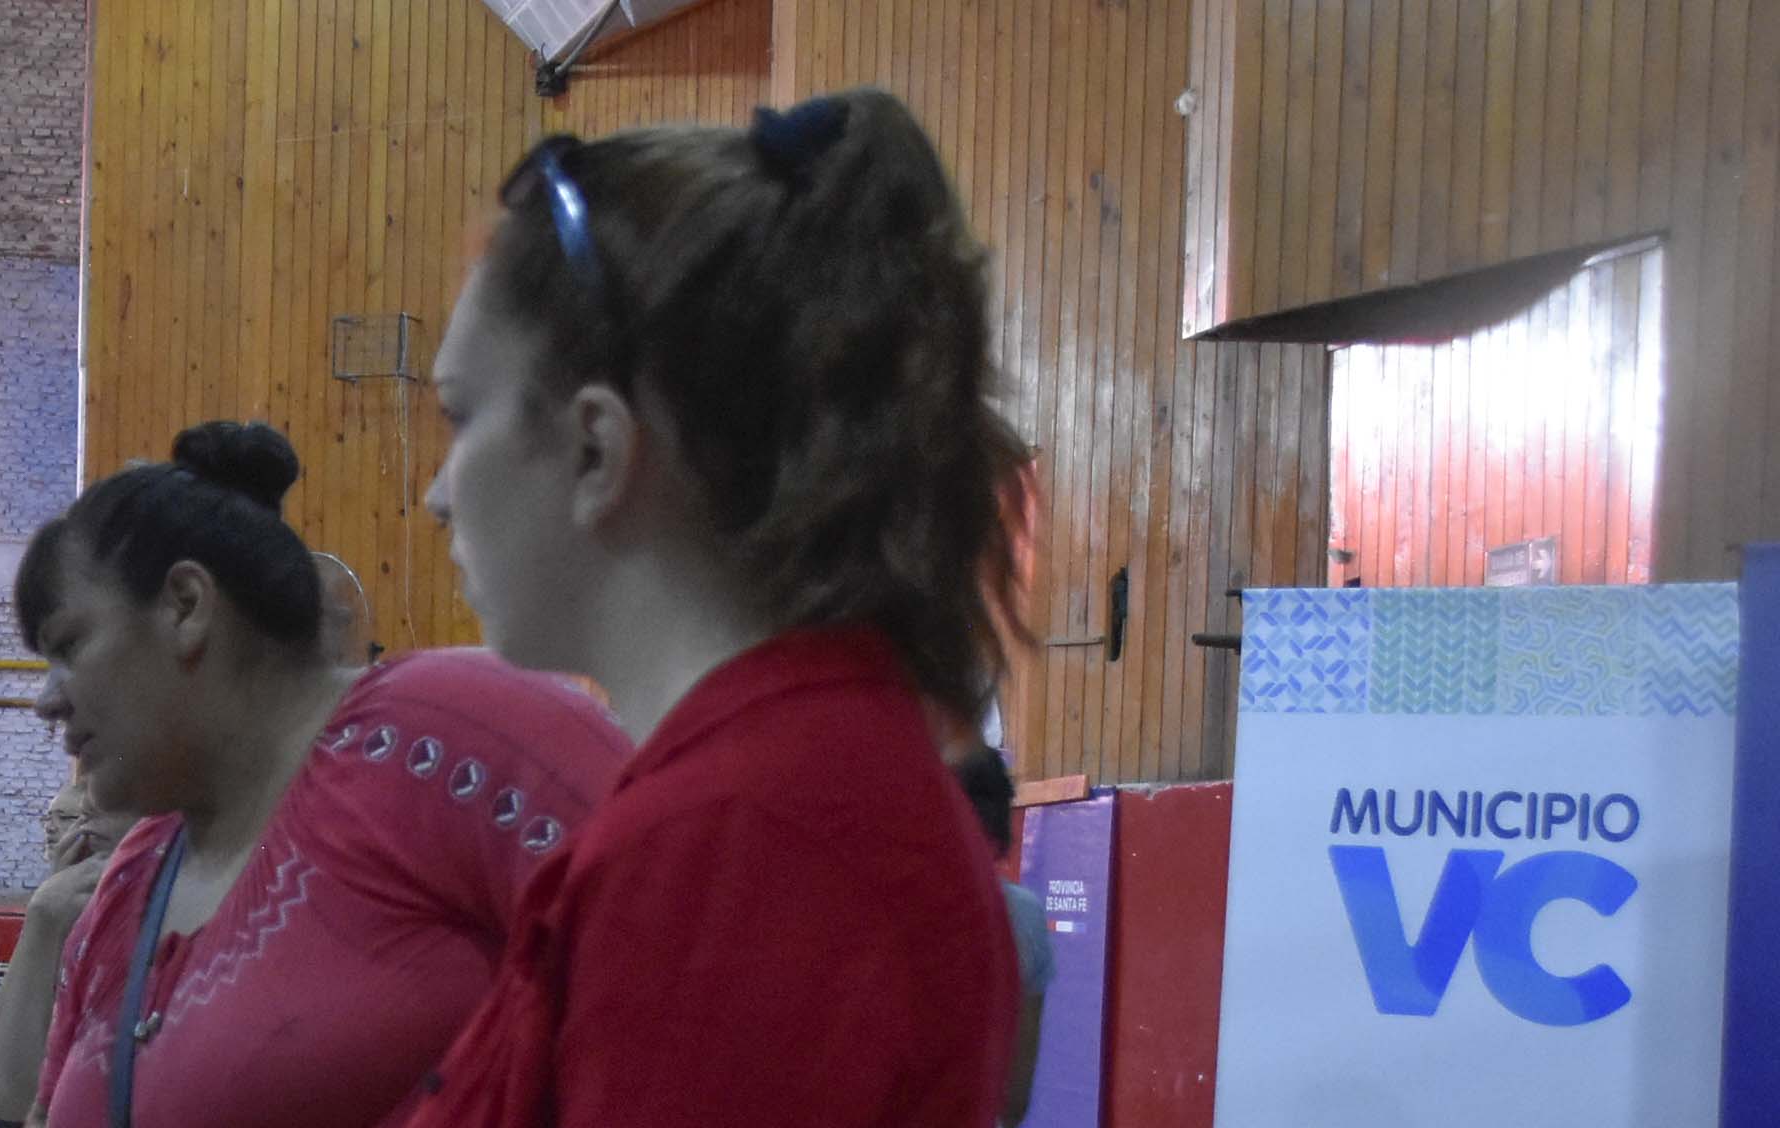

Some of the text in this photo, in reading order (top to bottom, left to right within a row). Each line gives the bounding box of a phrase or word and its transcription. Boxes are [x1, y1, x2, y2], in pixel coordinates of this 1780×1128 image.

[1329, 787, 1640, 843] MUNICIPIO
[1049, 880, 1084, 895] PROVINCIA
[1054, 896, 1078, 912] SANTA
[1327, 844, 1639, 1027] VC
